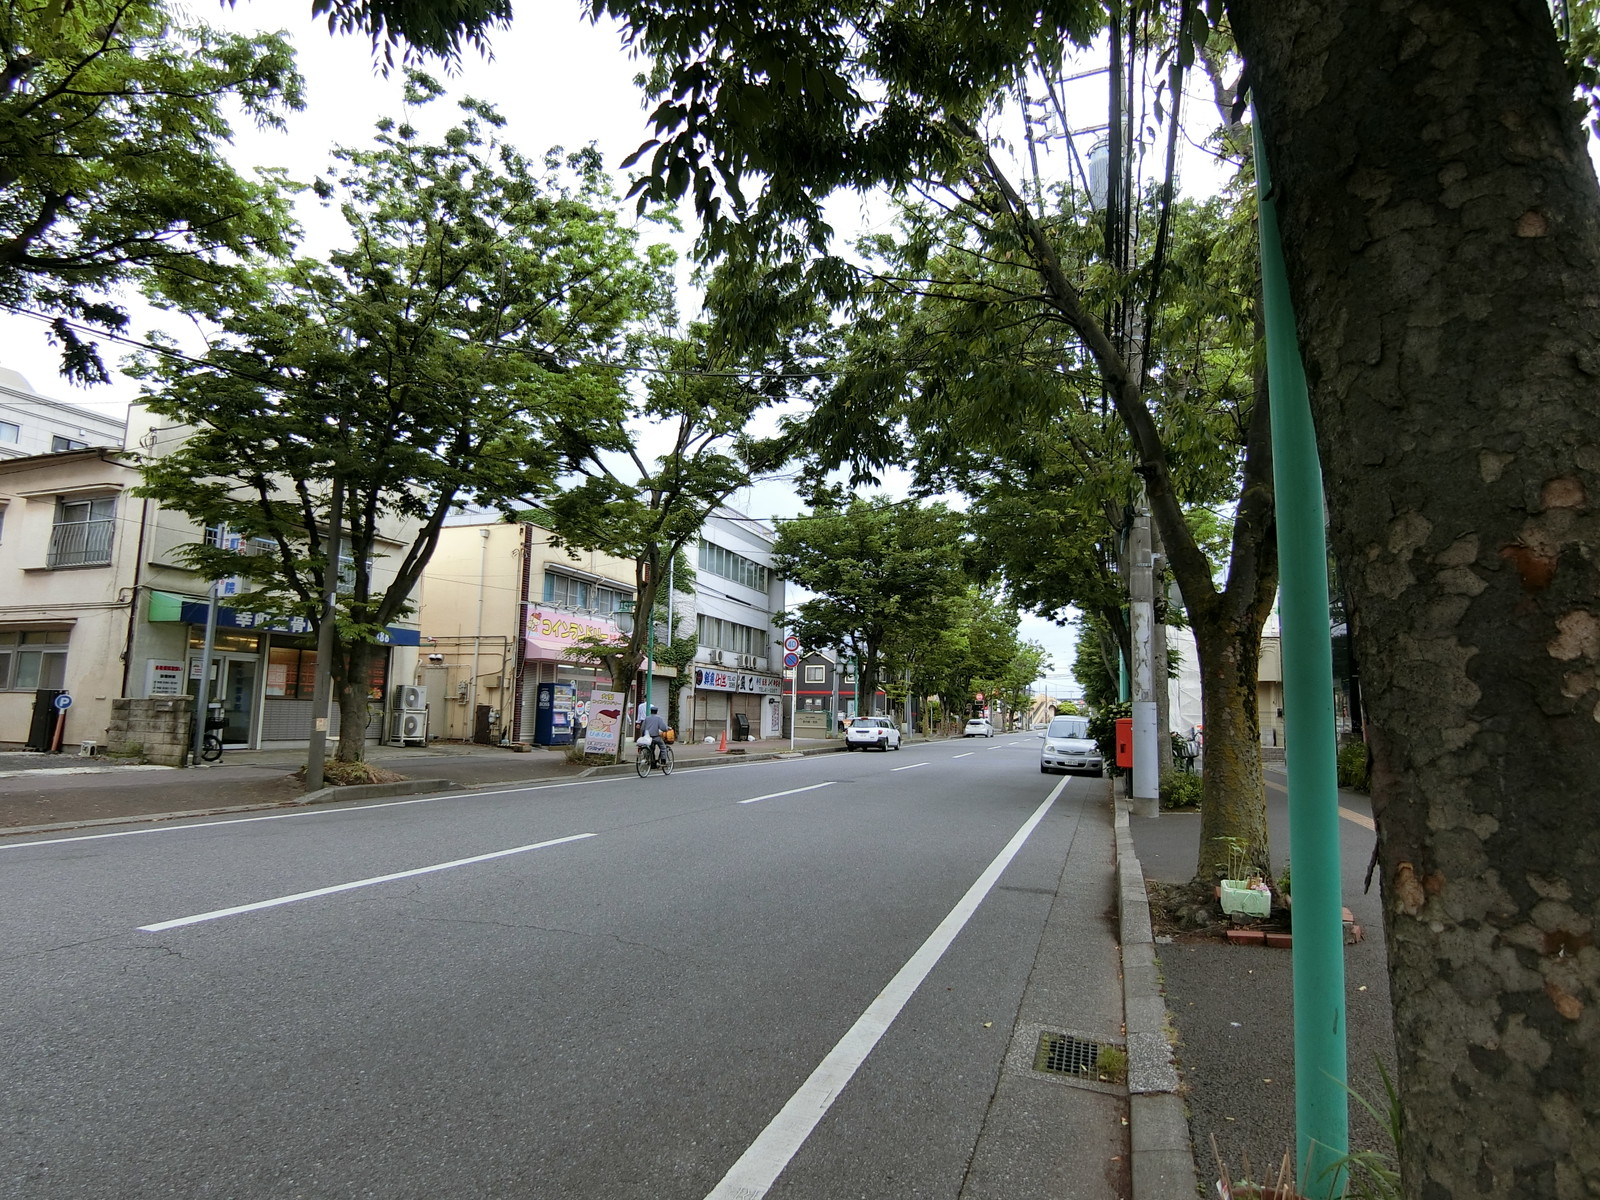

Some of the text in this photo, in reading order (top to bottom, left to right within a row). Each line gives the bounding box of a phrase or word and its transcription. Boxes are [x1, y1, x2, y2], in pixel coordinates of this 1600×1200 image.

[235, 612, 313, 633] 幸町骨
[542, 619, 608, 640] コインランドリー
[787, 640, 796, 648] 40
[60, 697, 70, 707] P
